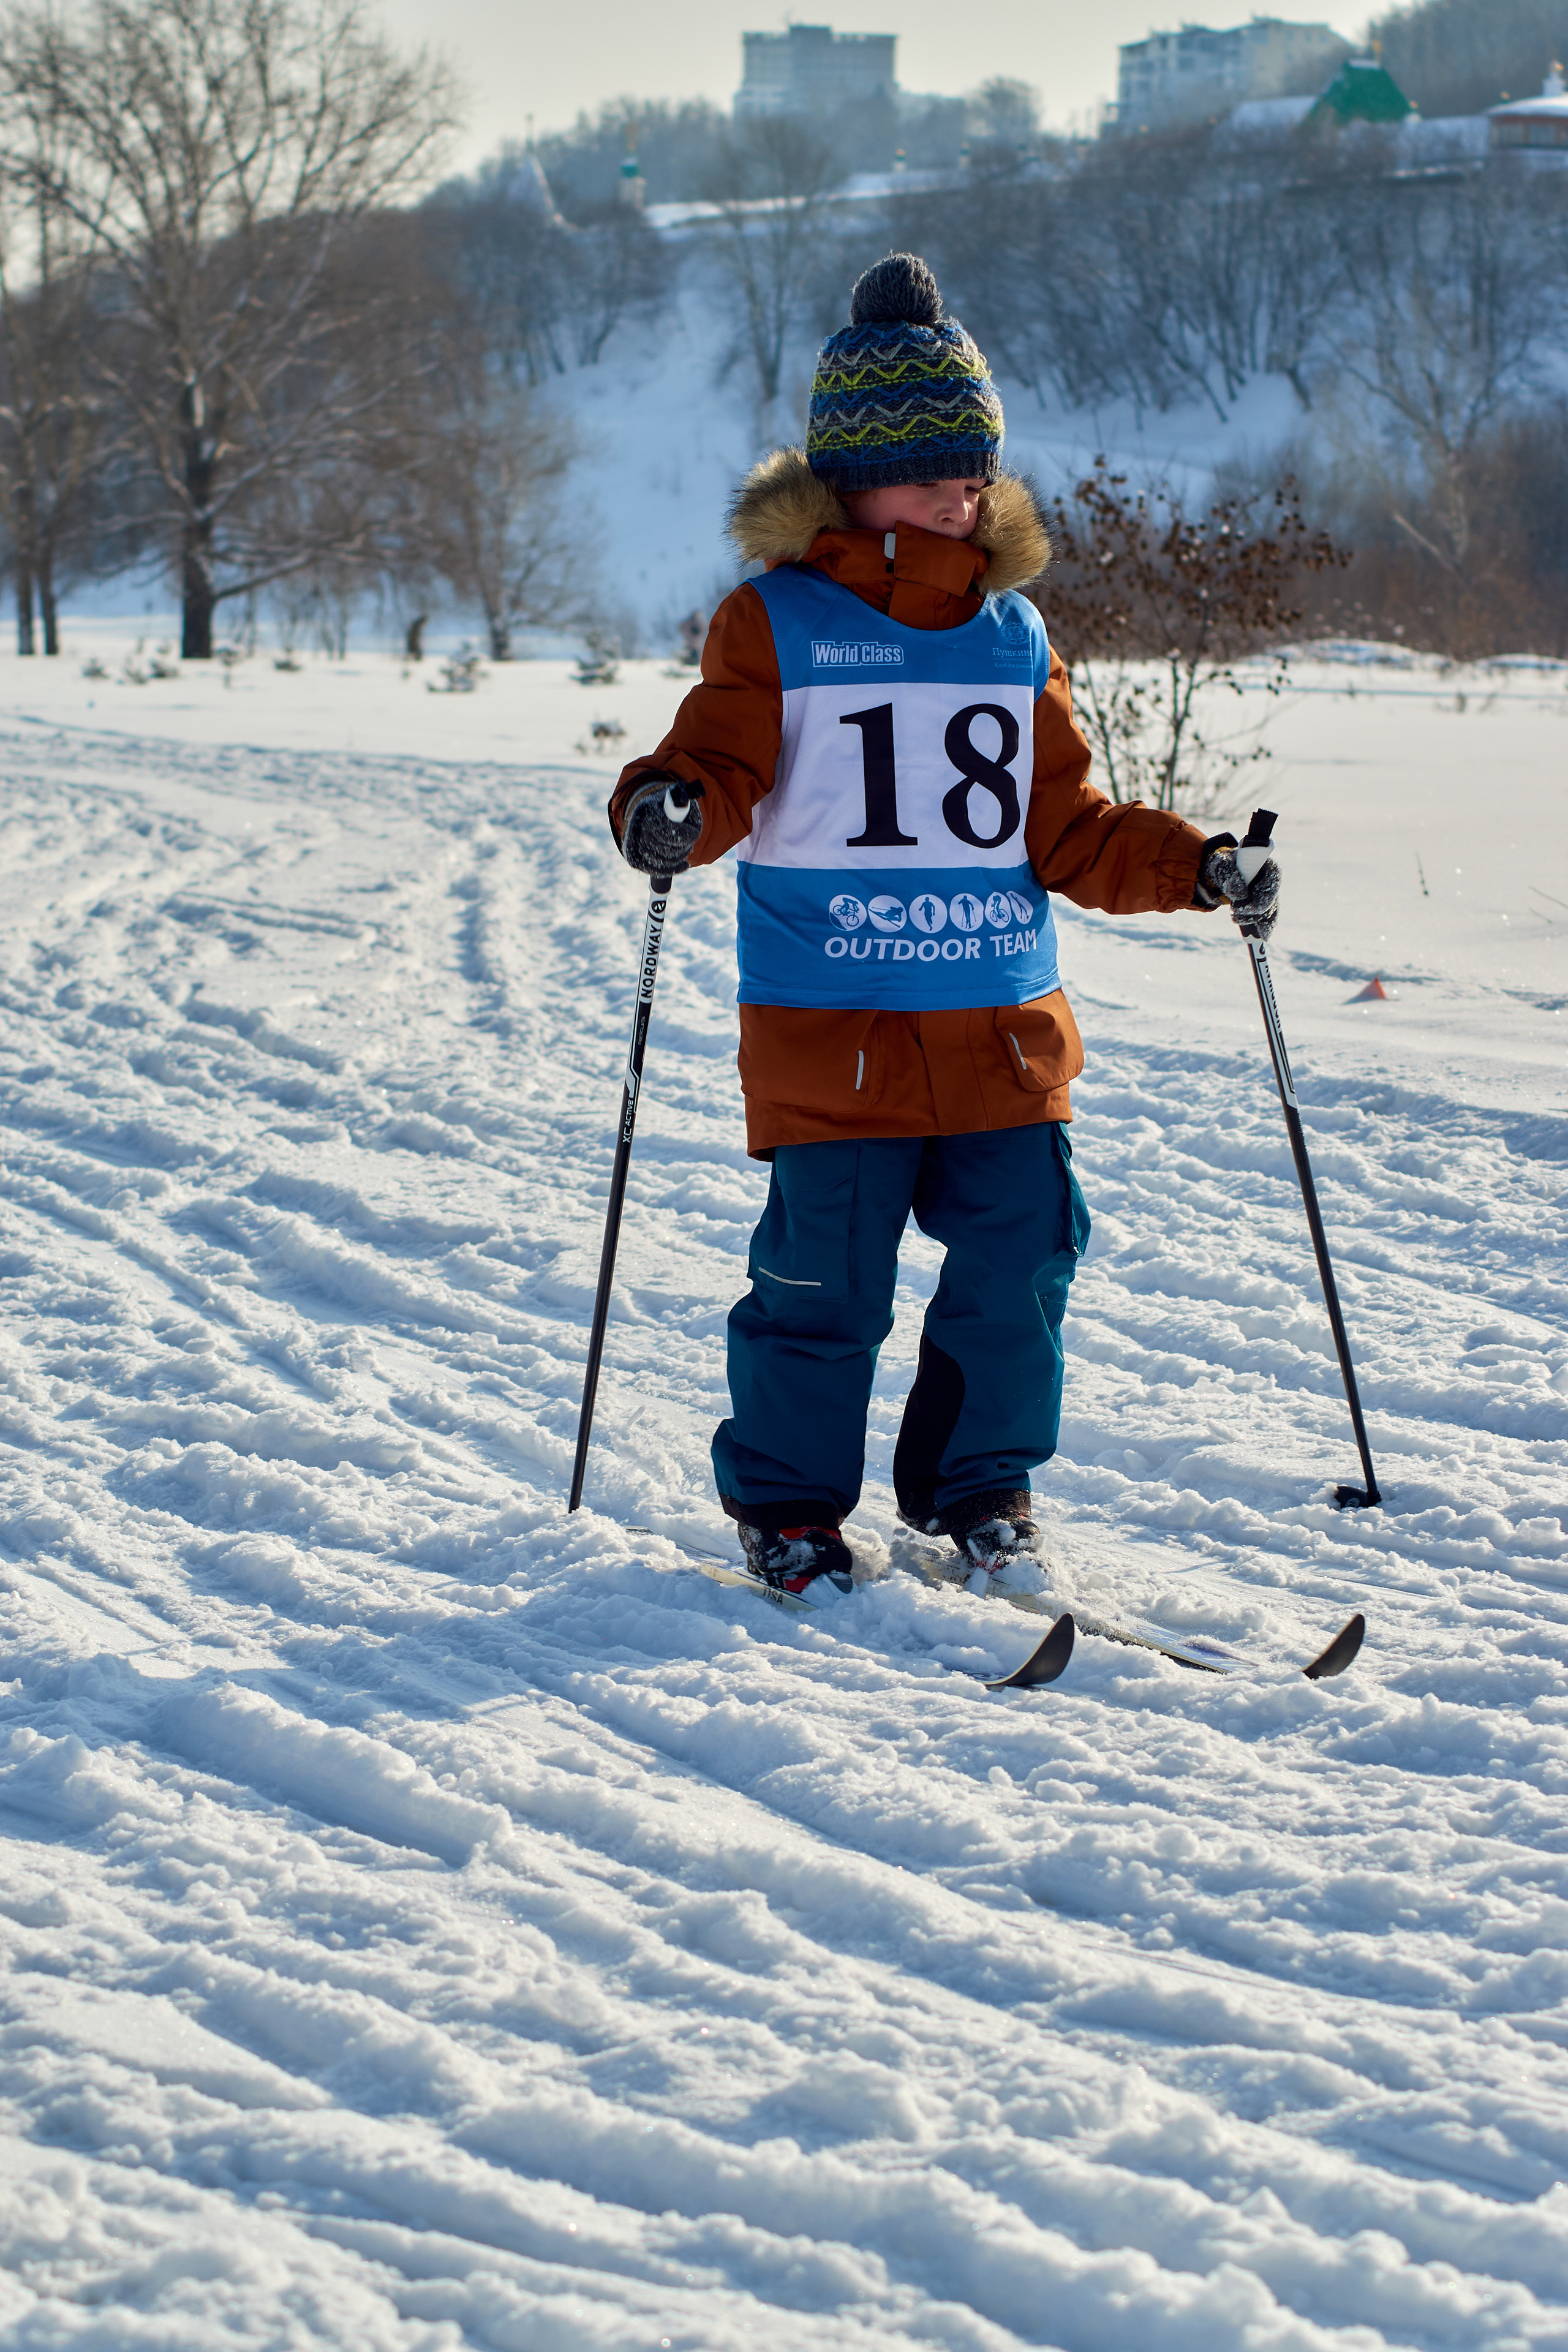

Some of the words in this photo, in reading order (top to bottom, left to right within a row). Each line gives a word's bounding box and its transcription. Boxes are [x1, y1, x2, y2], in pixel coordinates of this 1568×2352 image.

[815, 644, 858, 663] World
[861, 645, 901, 662] Class
[839, 702, 1021, 849] 18
[824, 937, 981, 962] OUTDOOR
[989, 929, 1037, 957] TEAM
[641, 924, 662, 998] NORDWAY
[625, 1099, 634, 1126] ACTIVE
[622, 1127, 632, 1143] XC
